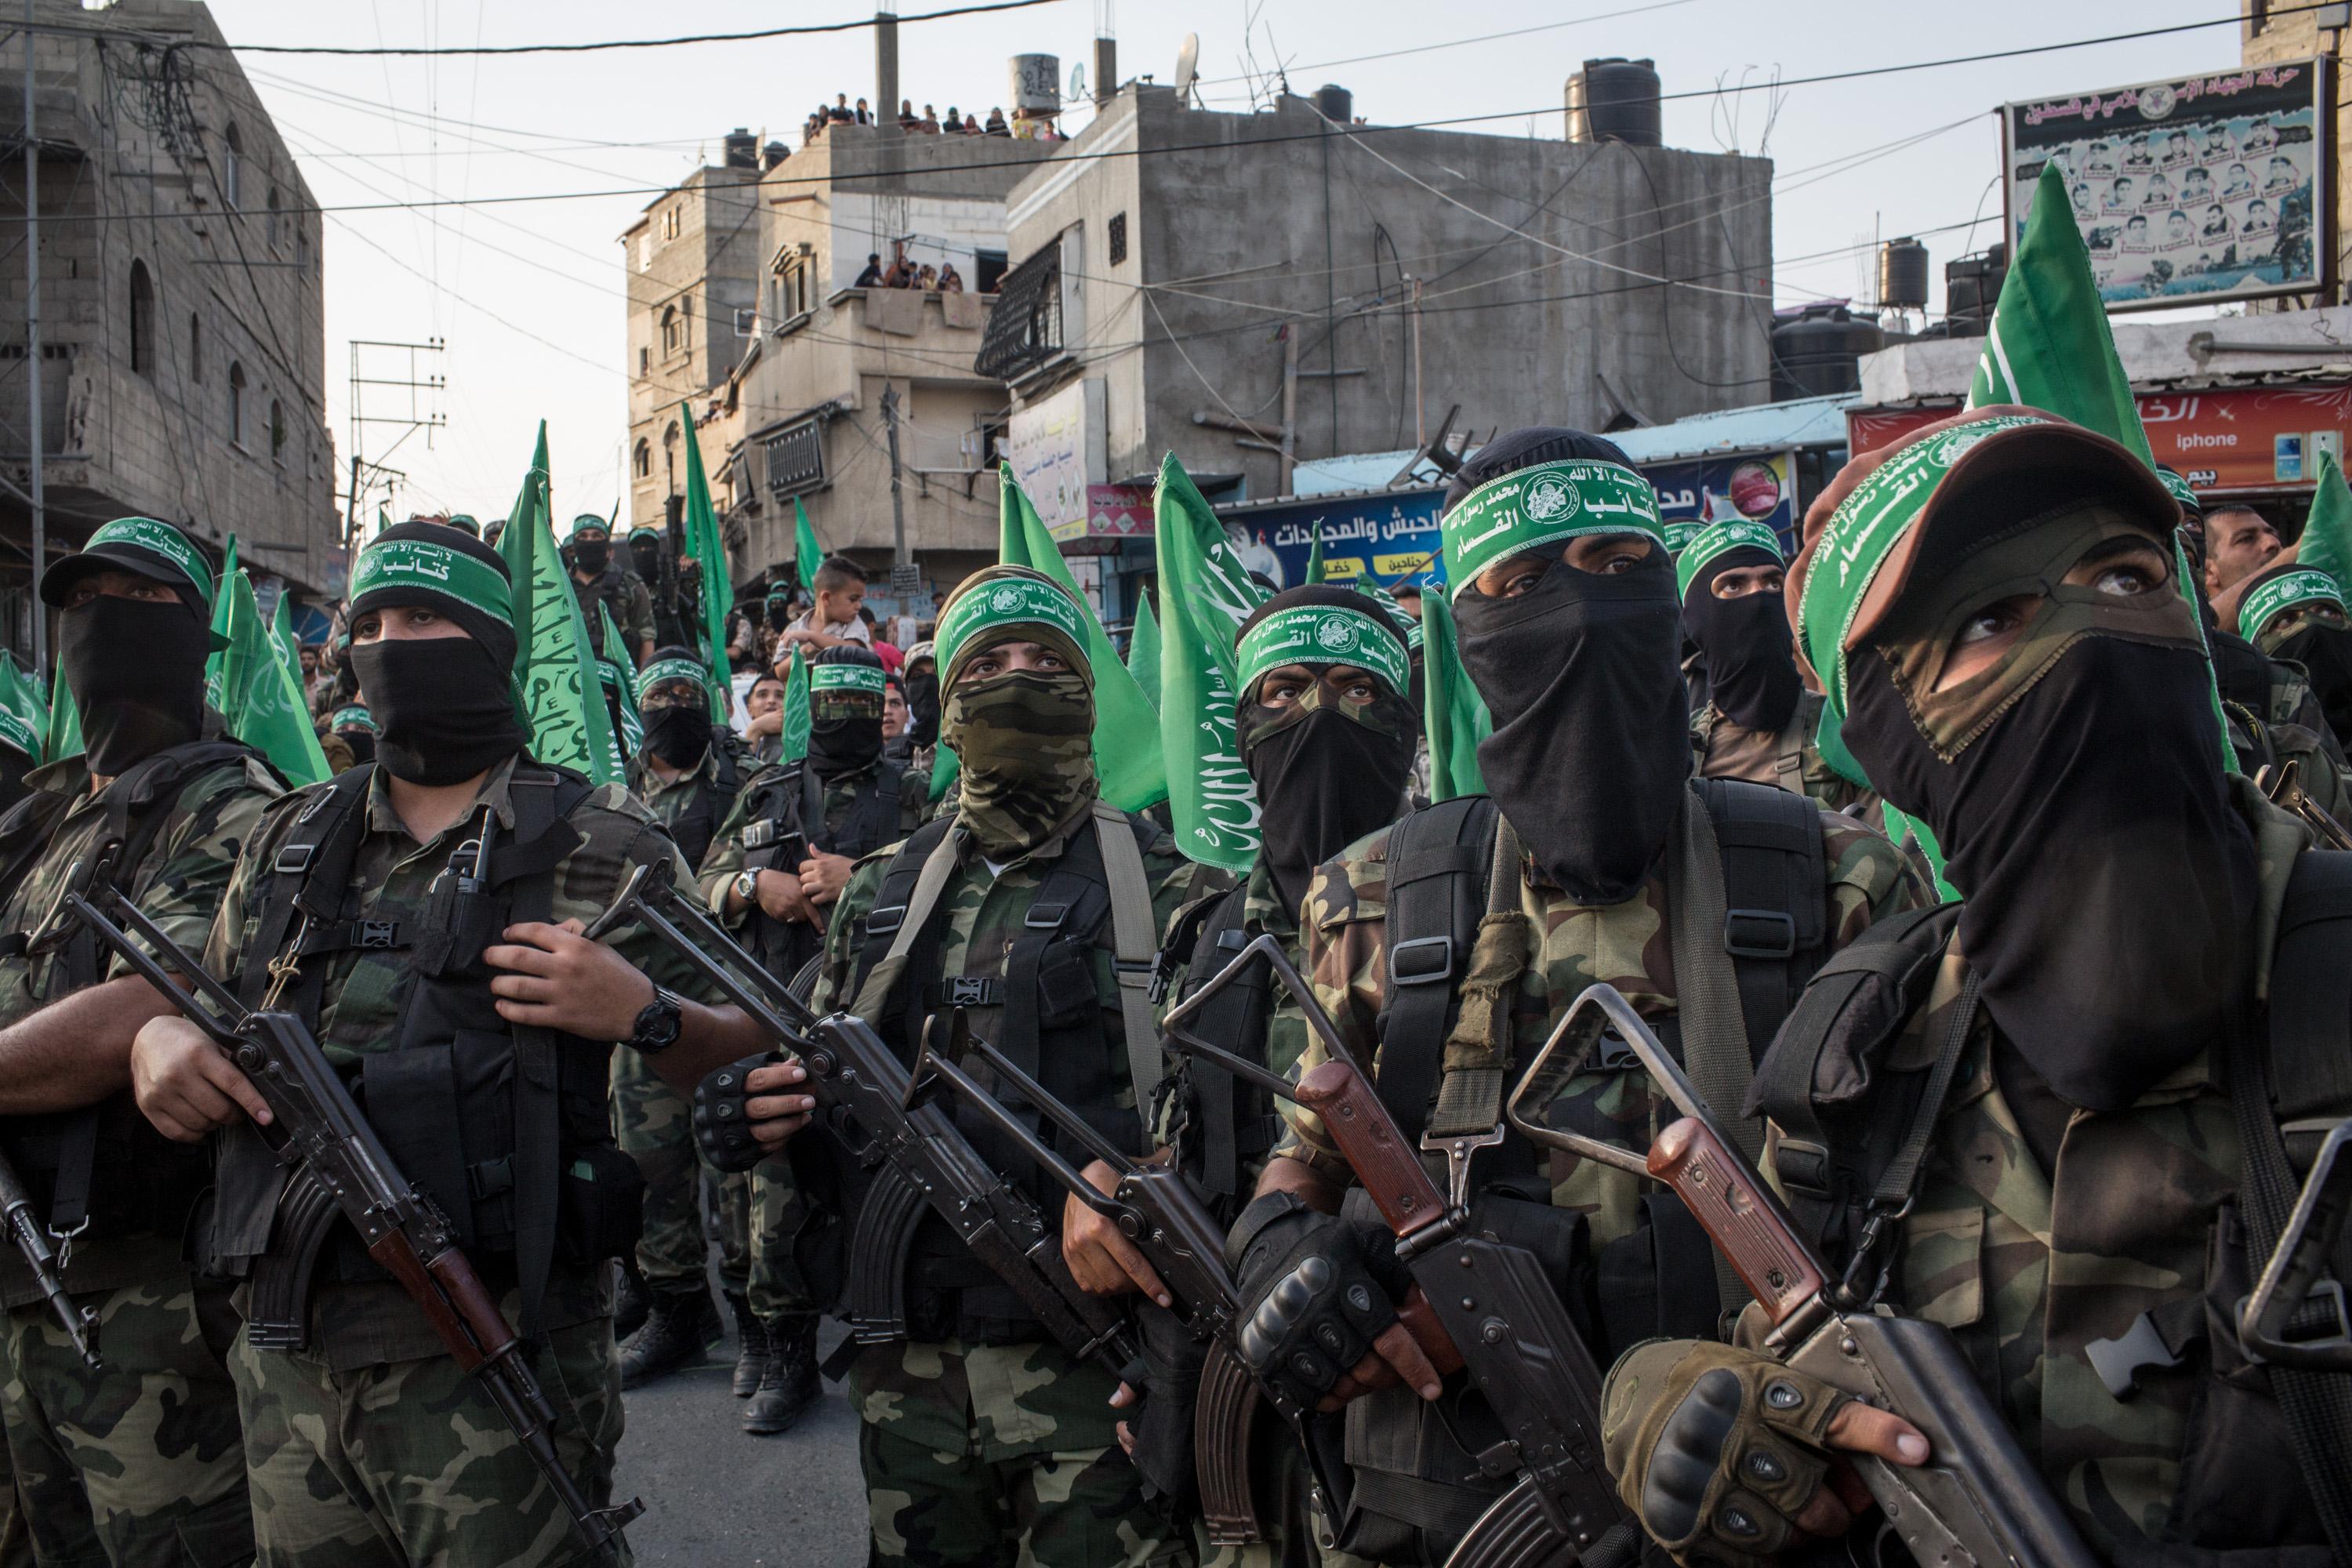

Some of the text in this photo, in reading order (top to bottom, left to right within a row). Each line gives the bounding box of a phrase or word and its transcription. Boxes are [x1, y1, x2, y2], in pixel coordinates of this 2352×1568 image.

[2205, 71, 2254, 96] الجهاد
[2256, 67, 2299, 89] حركة
[2024, 96, 2082, 125] فلسطين
[2082, 93, 2102, 120] في
[2176, 434, 2238, 452] iphone
[1569, 465, 1592, 481] الله
[1593, 466, 1612, 485] إلا
[1880, 449, 1927, 487] محمد
[1486, 482, 1521, 506] محمد
[1584, 488, 1657, 524] كتائب
[1461, 498, 1485, 527] رسول
[1841, 488, 1877, 536] رسول
[136, 521, 151, 530] الله
[1457, 507, 1519, 563] القسام
[1710, 528, 1727, 539] محمد
[1839, 466, 1929, 588] القسام
[135, 533, 189, 565] كتائب
[382, 544, 452, 562] لا إله إلا الله
[1693, 536, 1728, 566] القسام
[382, 555, 450, 582] كتائب
[1326, 561, 1350, 574] خضا
[967, 590, 989, 604] محمد
[1022, 583, 1036, 593] الله
[1287, 614, 1317, 626] محمد
[2249, 594, 2278, 627] القسام
[948, 599, 1076, 648] كتائب القسام
[1261, 620, 1285, 639] رسول
[1355, 619, 1371, 632] الله
[1251, 630, 1403, 684] كتائب القسام
